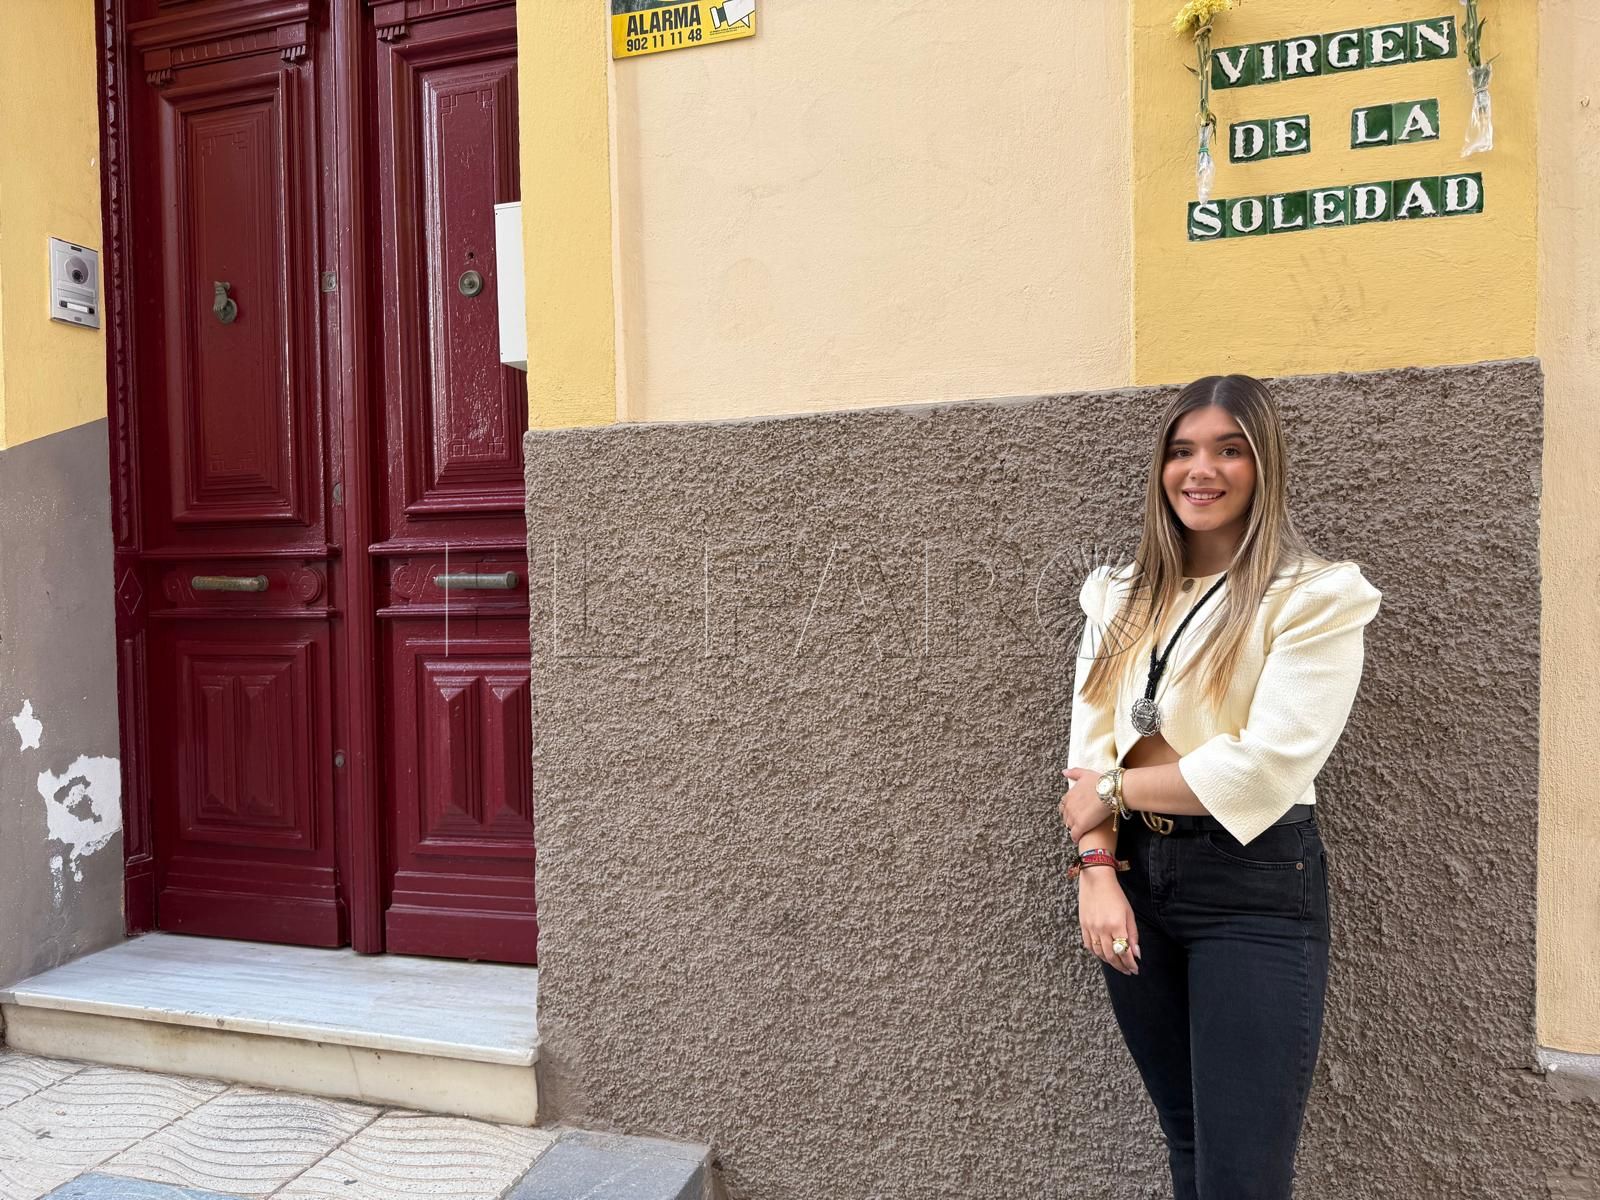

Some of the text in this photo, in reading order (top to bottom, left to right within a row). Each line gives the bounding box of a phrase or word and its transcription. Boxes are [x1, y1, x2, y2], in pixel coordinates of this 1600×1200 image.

[626, 5, 701, 37] ALARMA
[626, 37, 648, 52] 902
[652, 34, 665, 48] 11
[671, 31, 683, 46] 11
[687, 28, 702, 42] 48
[1214, 20, 1450, 84] VIRGEN
[1233, 104, 1437, 158] DE LA
[1191, 177, 1479, 236] SOLEDAD
